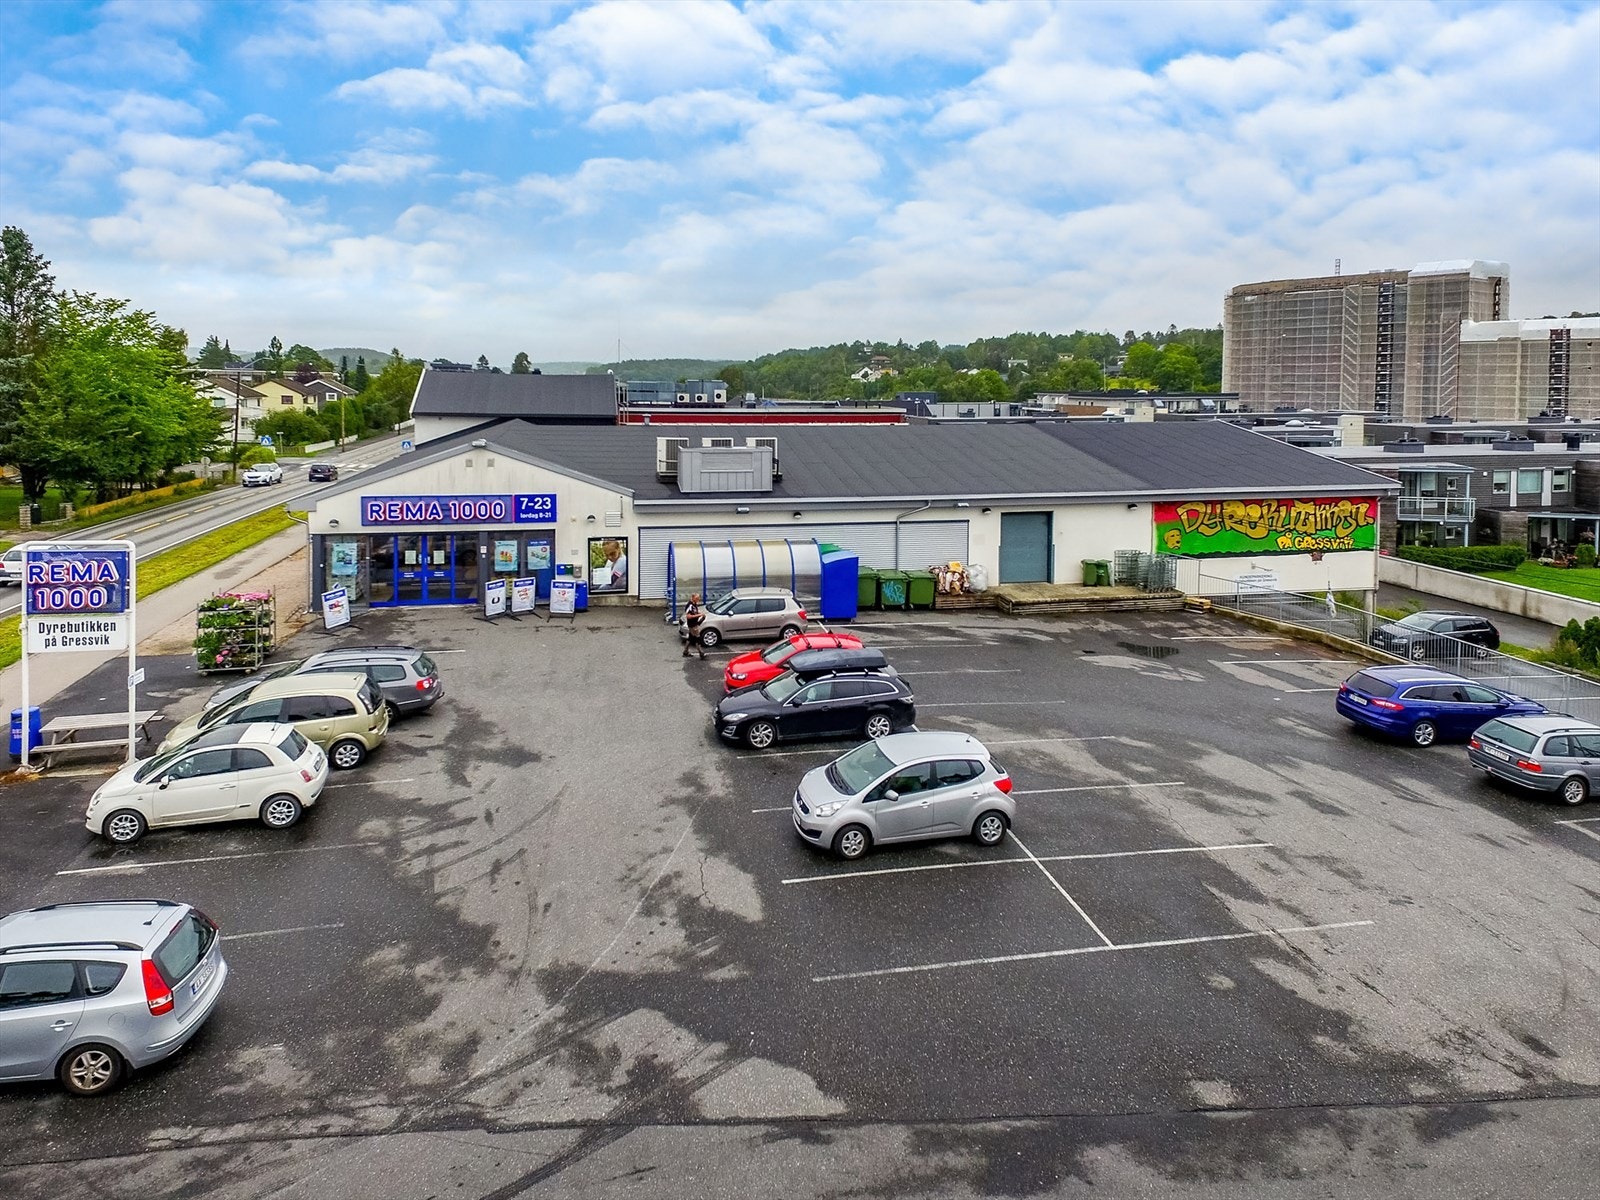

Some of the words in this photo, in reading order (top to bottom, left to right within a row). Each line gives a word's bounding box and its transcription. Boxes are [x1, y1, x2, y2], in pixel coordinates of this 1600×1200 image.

[367, 501, 443, 521] REMA
[450, 500, 505, 519] 1000
[519, 497, 552, 510] 7-23
[28, 561, 119, 583] REMA
[37, 587, 107, 610] 1000
[38, 621, 117, 635] Dyrebutikken
[44, 635, 57, 649] på
[61, 634, 110, 647] Gressvik
